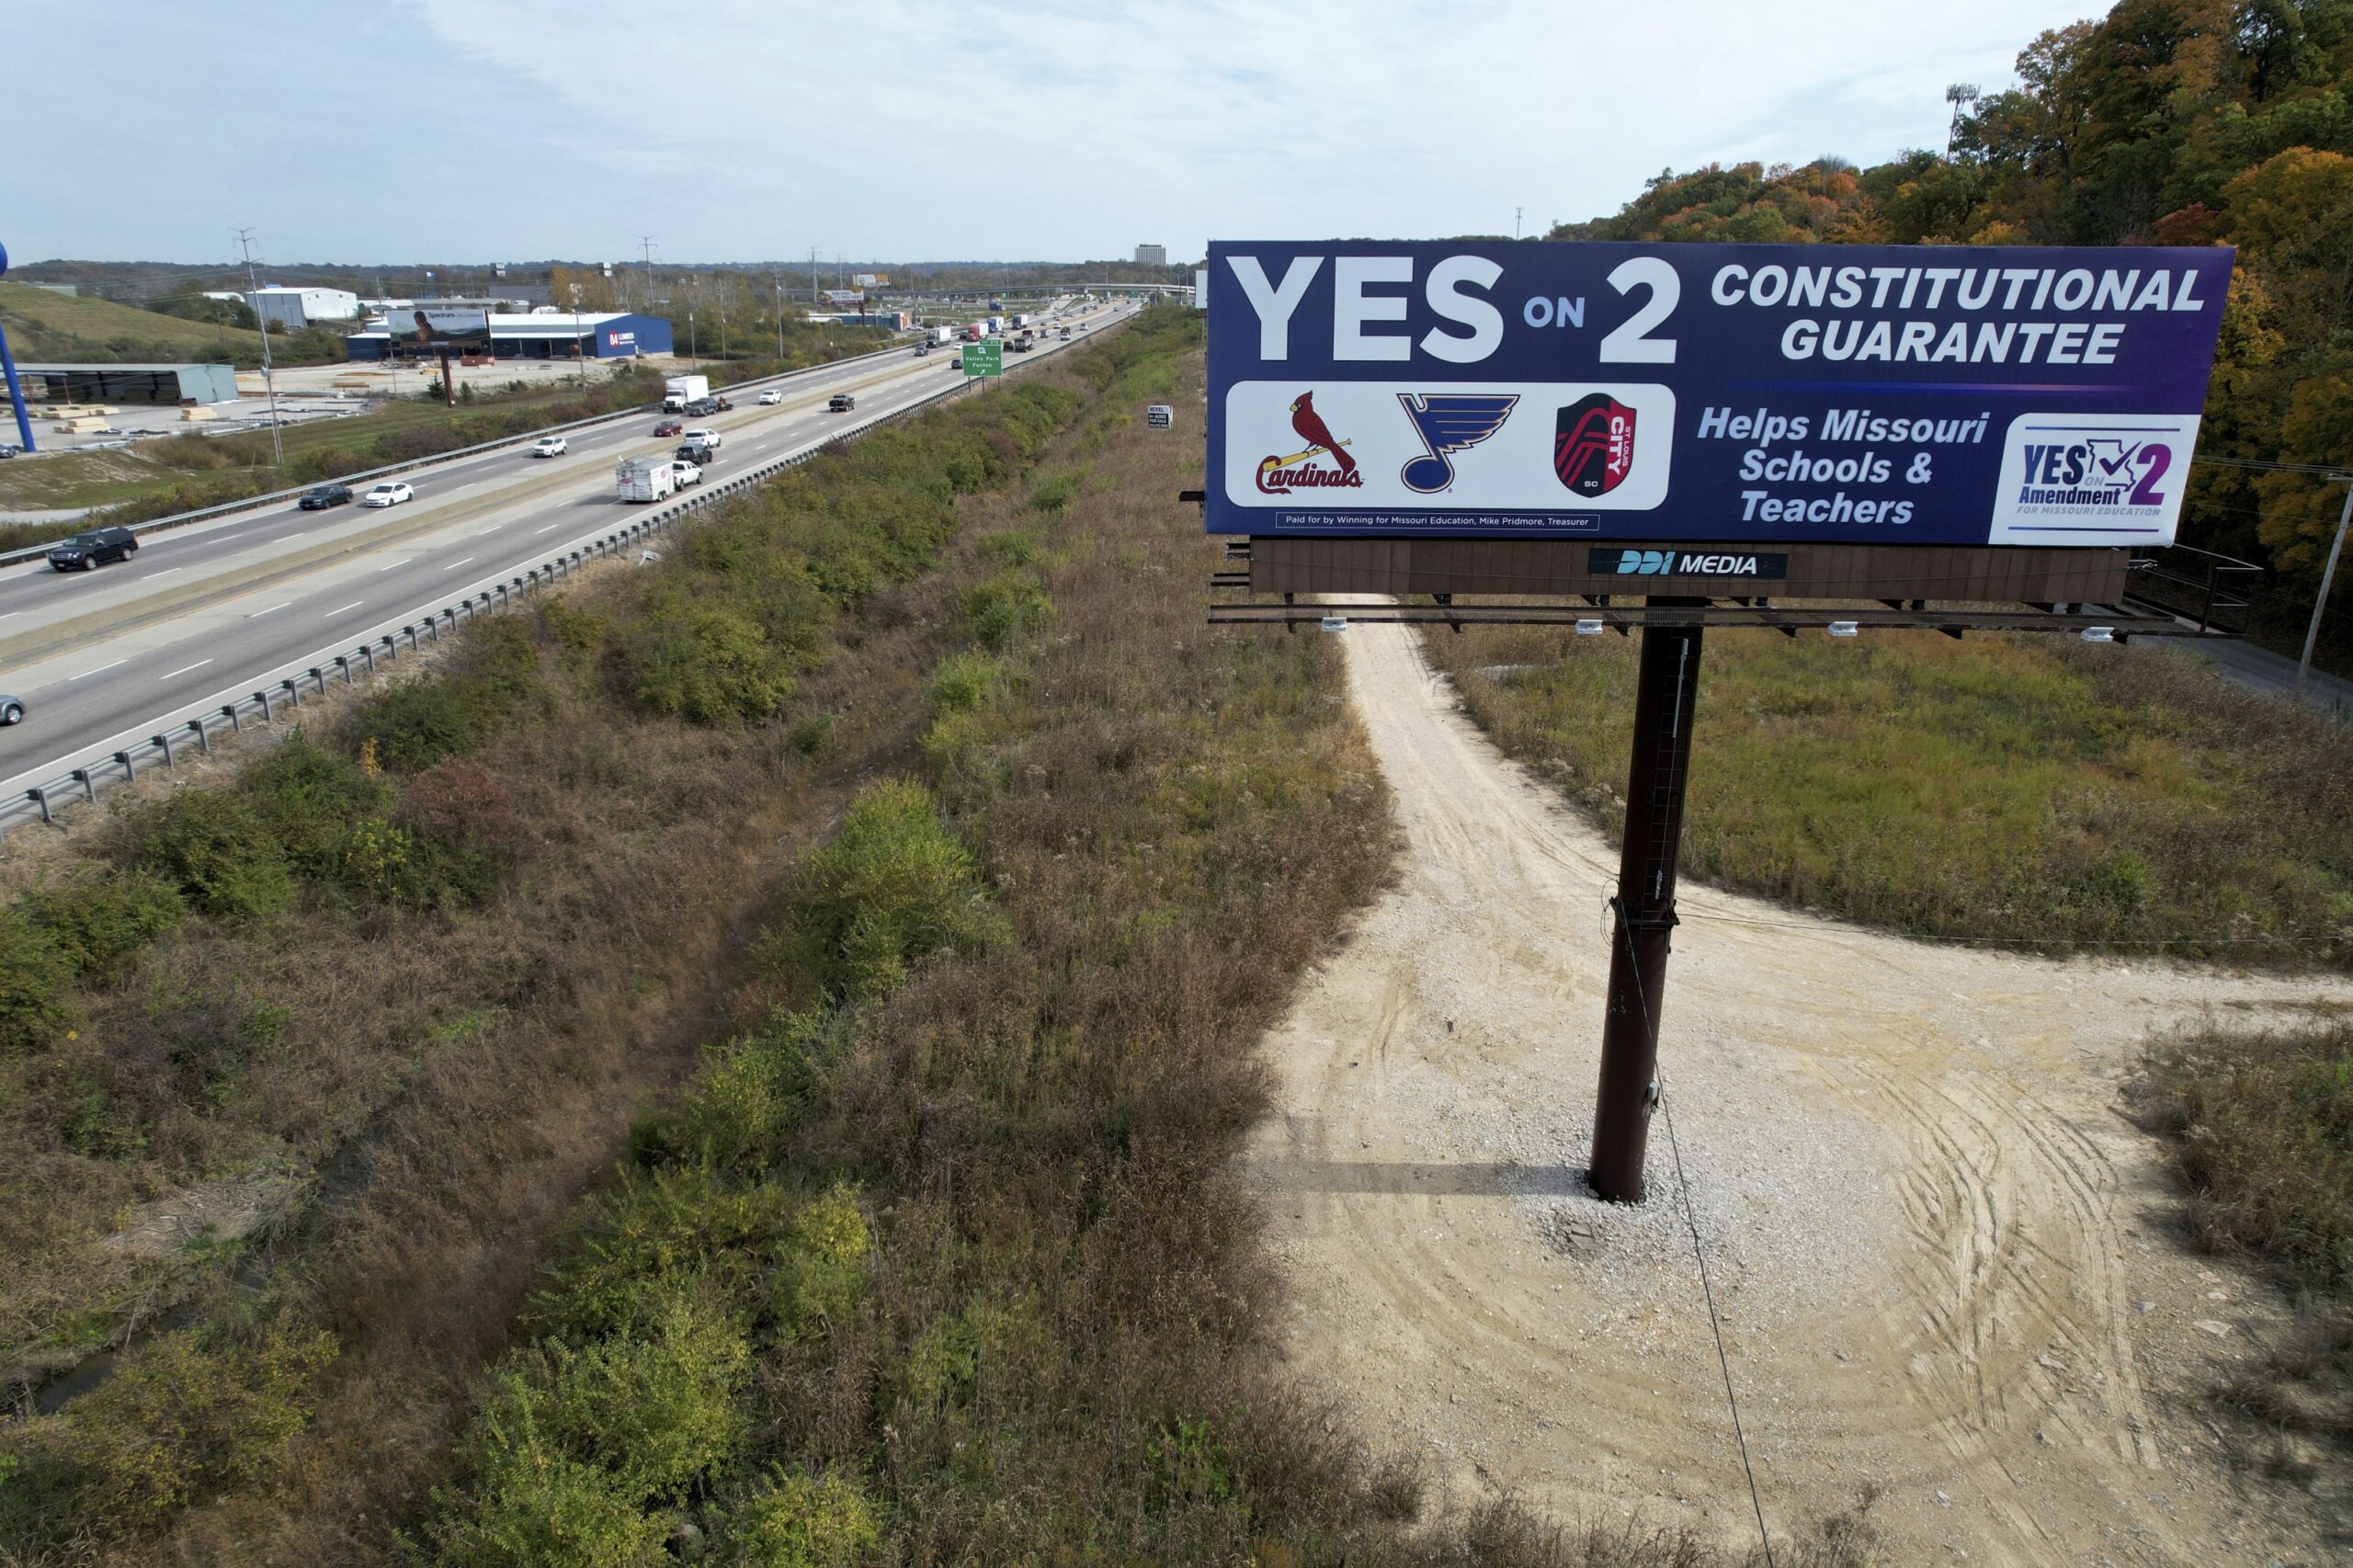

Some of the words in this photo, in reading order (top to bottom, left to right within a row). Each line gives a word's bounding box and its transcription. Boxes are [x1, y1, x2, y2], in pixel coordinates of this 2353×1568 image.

[1711, 264, 2206, 312] CONSTITUTIONAL
[1225, 256, 1505, 363] YES
[1523, 296, 1586, 328] ON
[1599, 256, 1682, 364] 2
[1780, 319, 2126, 365] GUARANTEE
[1608, 415, 1624, 476] CITY
[1697, 406, 1811, 448] Helps
[1821, 408, 1990, 445] Missouri
[1621, 441, 1630, 467] LOUIS
[1739, 448, 1893, 484] Schools
[1905, 453, 1933, 484] &
[2024, 445, 2086, 485] YES
[1256, 455, 1365, 494] Cardinals
[2084, 476, 2105, 486] ON
[2129, 443, 2172, 506] 2
[1740, 490, 1915, 525] Teachers
[2017, 506, 2038, 515] FOR
[2040, 506, 2095, 516] MISSOURI
[2097, 507, 2161, 516] EDUCATION
[2018, 486, 2121, 506] Amendment
[1286, 516, 1305, 524] Paid
[1308, 516, 1321, 524] for
[1324, 516, 1335, 525] by
[1337, 516, 1373, 525] Winning
[1376, 516, 1389, 524] for
[1430, 517, 1477, 526] Education,
[1479, 517, 1500, 525] Mike
[1502, 517, 1545, 527] Pridmore,
[1548, 517, 1589, 526] Treasurer
[1678, 554, 1757, 574] MEDIA
